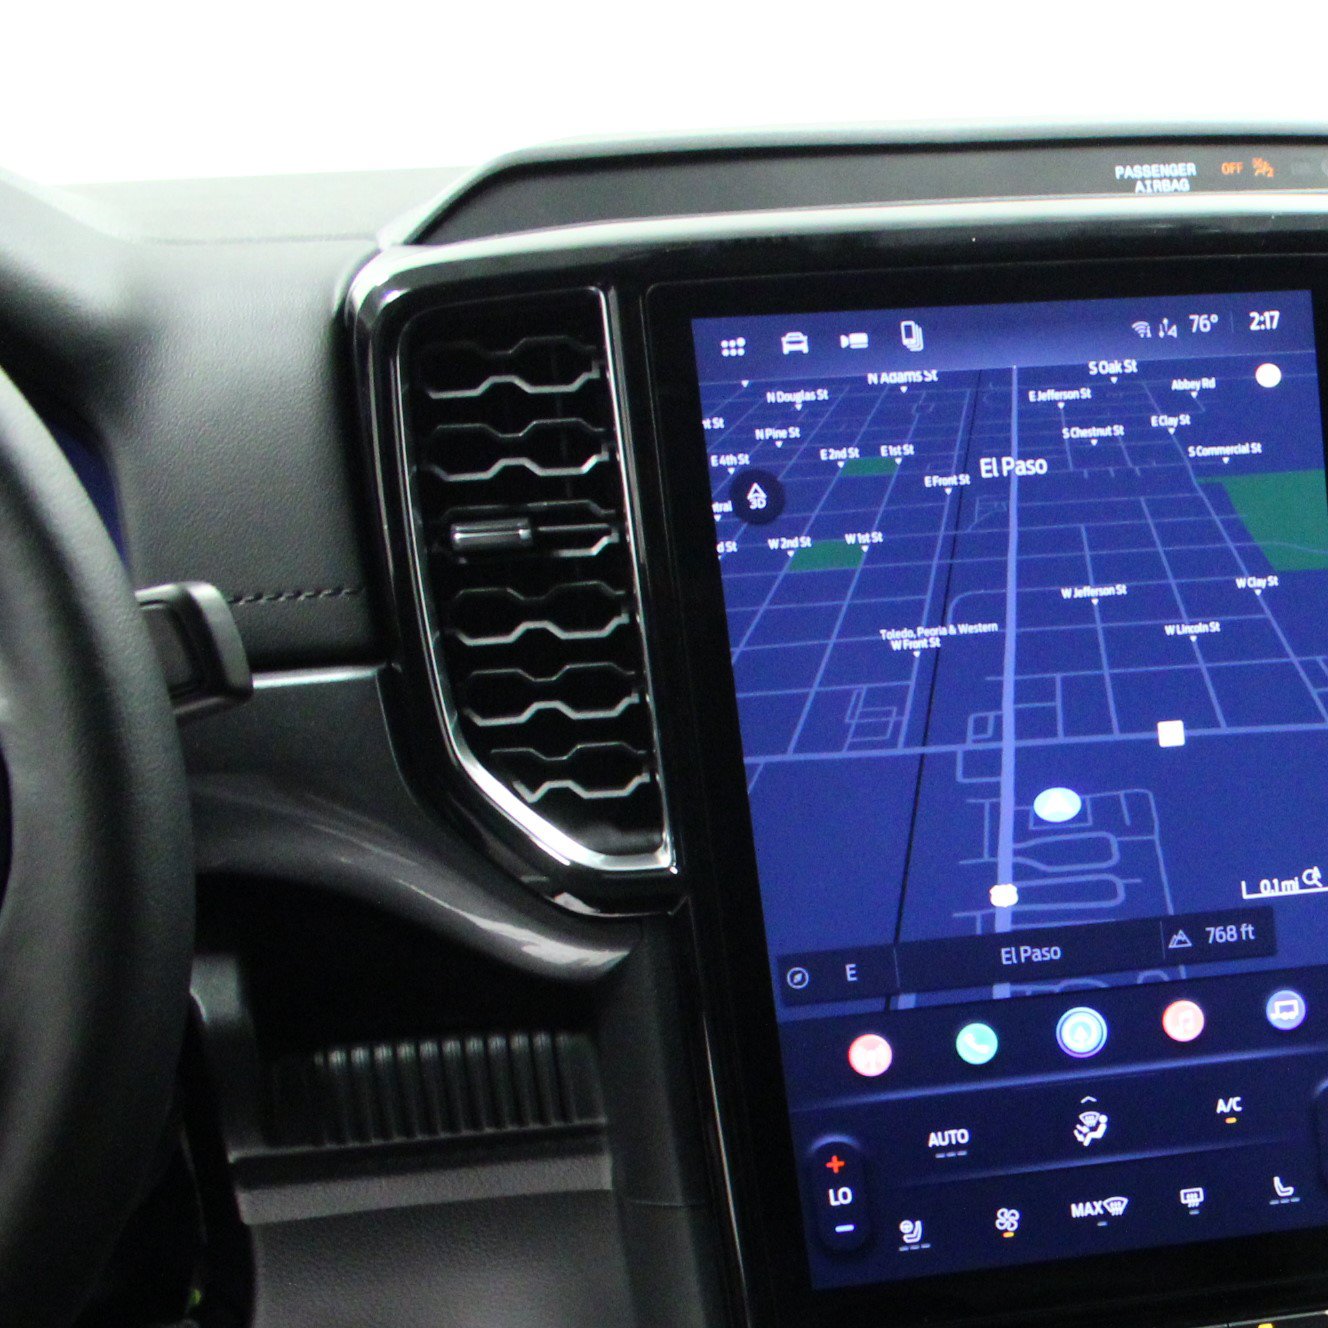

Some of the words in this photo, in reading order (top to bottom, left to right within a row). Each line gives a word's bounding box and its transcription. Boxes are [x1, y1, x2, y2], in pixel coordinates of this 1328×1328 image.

[1114, 162, 1197, 180] PASSENGER
[1221, 161, 1244, 175] OFF
[1134, 177, 1191, 194] AIRBAG
[1249, 310, 1280, 331] 2:17
[1088, 360, 1098, 375] S
[1099, 360, 1123, 374] Oak
[1123, 359, 1138, 373] St
[867, 372, 878, 385] N
[923, 369, 938, 382] St
[1171, 378, 1201, 391] Abbey
[1201, 377, 1216, 389] Rd
[766, 391, 776, 403] N
[776, 390, 815, 405] Douglas
[815, 389, 829, 401] St
[1028, 391, 1037, 402] E
[1037, 388, 1080, 401] Jefferson
[1080, 387, 1092, 399] St
[1151, 415, 1158, 427] E
[1157, 415, 1179, 428] Clay
[1179, 414, 1191, 425] St
[755, 429, 765, 440] N
[765, 428, 788, 439] Pine
[788, 427, 801, 438] St
[1062, 428, 1070, 439] S
[1070, 426, 1112, 438] Chestnut
[1112, 425, 1125, 436] St
[820, 449, 828, 461] E
[828, 447, 847, 460] 2nd
[847, 447, 860, 459] St
[880, 445, 889, 457] E
[888, 445, 902, 456] 1st
[903, 444, 914, 455] St
[1188, 446, 1196, 457] S
[1195, 443, 1250, 457] Commercial
[1250, 442, 1262, 454] St
[711, 455, 719, 467] E
[719, 454, 737, 466] 4th
[738, 453, 750, 465] St
[980, 457, 999, 478] El
[1002, 456, 1048, 477] Paso
[924, 476, 932, 487] E
[932, 474, 958, 486] Front
[958, 473, 971, 485] St
[749, 498, 767, 510] 3D
[767, 538, 780, 550] W
[780, 537, 800, 549] 2nd
[800, 536, 812, 547] St
[845, 533, 857, 545] W
[857, 532, 871, 544] 1st
[871, 531, 883, 543] St
[1235, 577, 1247, 589] W
[1247, 576, 1267, 589] Clay
[1267, 575, 1279, 587] St
[1061, 587, 1073, 599] W
[1073, 585, 1115, 598] Jefferson
[1116, 584, 1127, 595] St
[916, 625, 948, 637] Peoria
[957, 622, 999, 634] Western
[1164, 624, 1176, 636] W
[1176, 622, 1209, 635] Lincoln
[1209, 621, 1221, 633] St
[890, 639, 902, 651] W
[902, 638, 928, 650] Front
[929, 636, 941, 648] St
[1260, 879, 1281, 894] 0.1
[1281, 876, 1299, 891] mi
[1205, 924, 1237, 944] 768
[1240, 923, 1254, 941] ft
[1000, 947, 1016, 965] El
[1020, 945, 1061, 962] Paso
[845, 963, 858, 982] E
[1216, 1096, 1243, 1115] A/C
[928, 1127, 970, 1149] AUTO
[828, 1186, 853, 1207] LO
[1070, 1199, 1104, 1219] MAX
